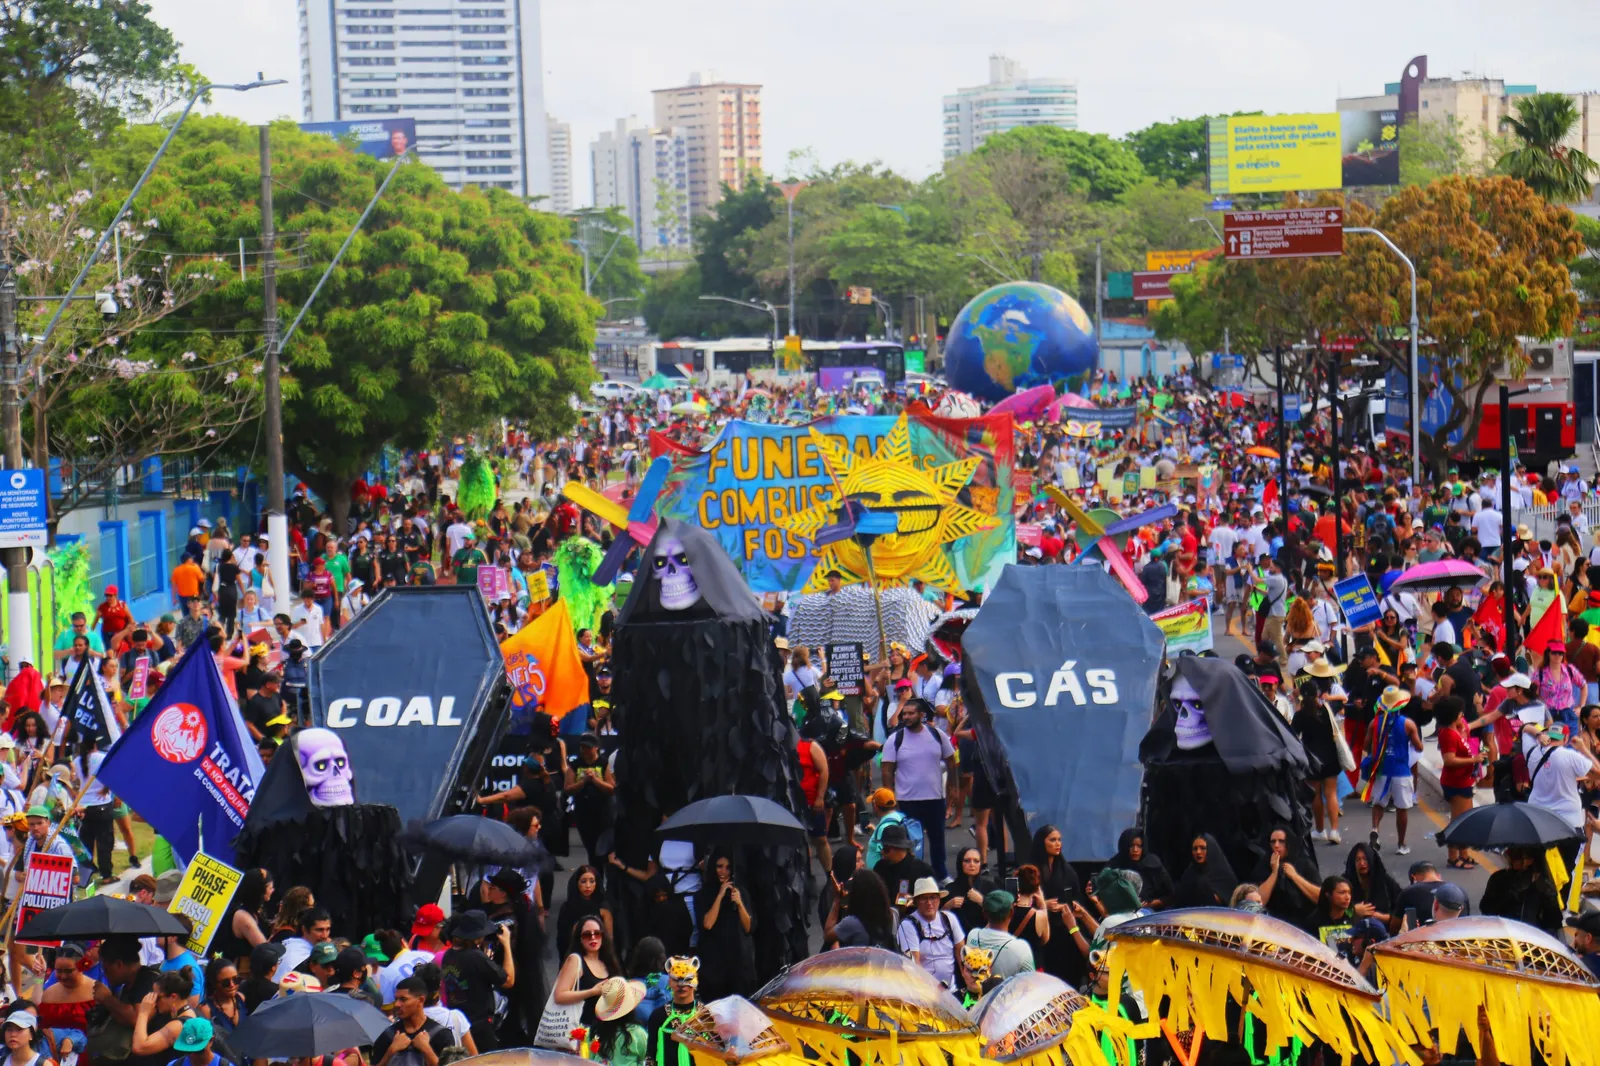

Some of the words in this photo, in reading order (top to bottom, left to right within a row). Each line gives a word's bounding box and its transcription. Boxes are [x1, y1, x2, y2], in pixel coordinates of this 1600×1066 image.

[1302, 130, 1336, 141] planeta
[1234, 213, 1253, 221] Visite
[1262, 212, 1287, 222] Parque
[1284, 227, 1323, 236] Rodoviário
[1253, 241, 1289, 250] Aeroporto
[995, 660, 1119, 708] GÁS
[326, 696, 462, 728] COAL
[202, 760, 211, 772] DE
[210, 770, 223, 784] NO
[194, 768, 202, 781] DE
[202, 778, 242, 827] COMBUSTIBLES
[192, 866, 228, 896] PHASE
[195, 853, 208, 866] FAST
[206, 859, 219, 871] AND
[216, 864, 241, 883] FOREVER
[26, 868, 69, 896] MAKE
[23, 894, 66, 909] POLLUTERS
[191, 885, 214, 906] OUT
[176, 896, 213, 926] FOSSIL
